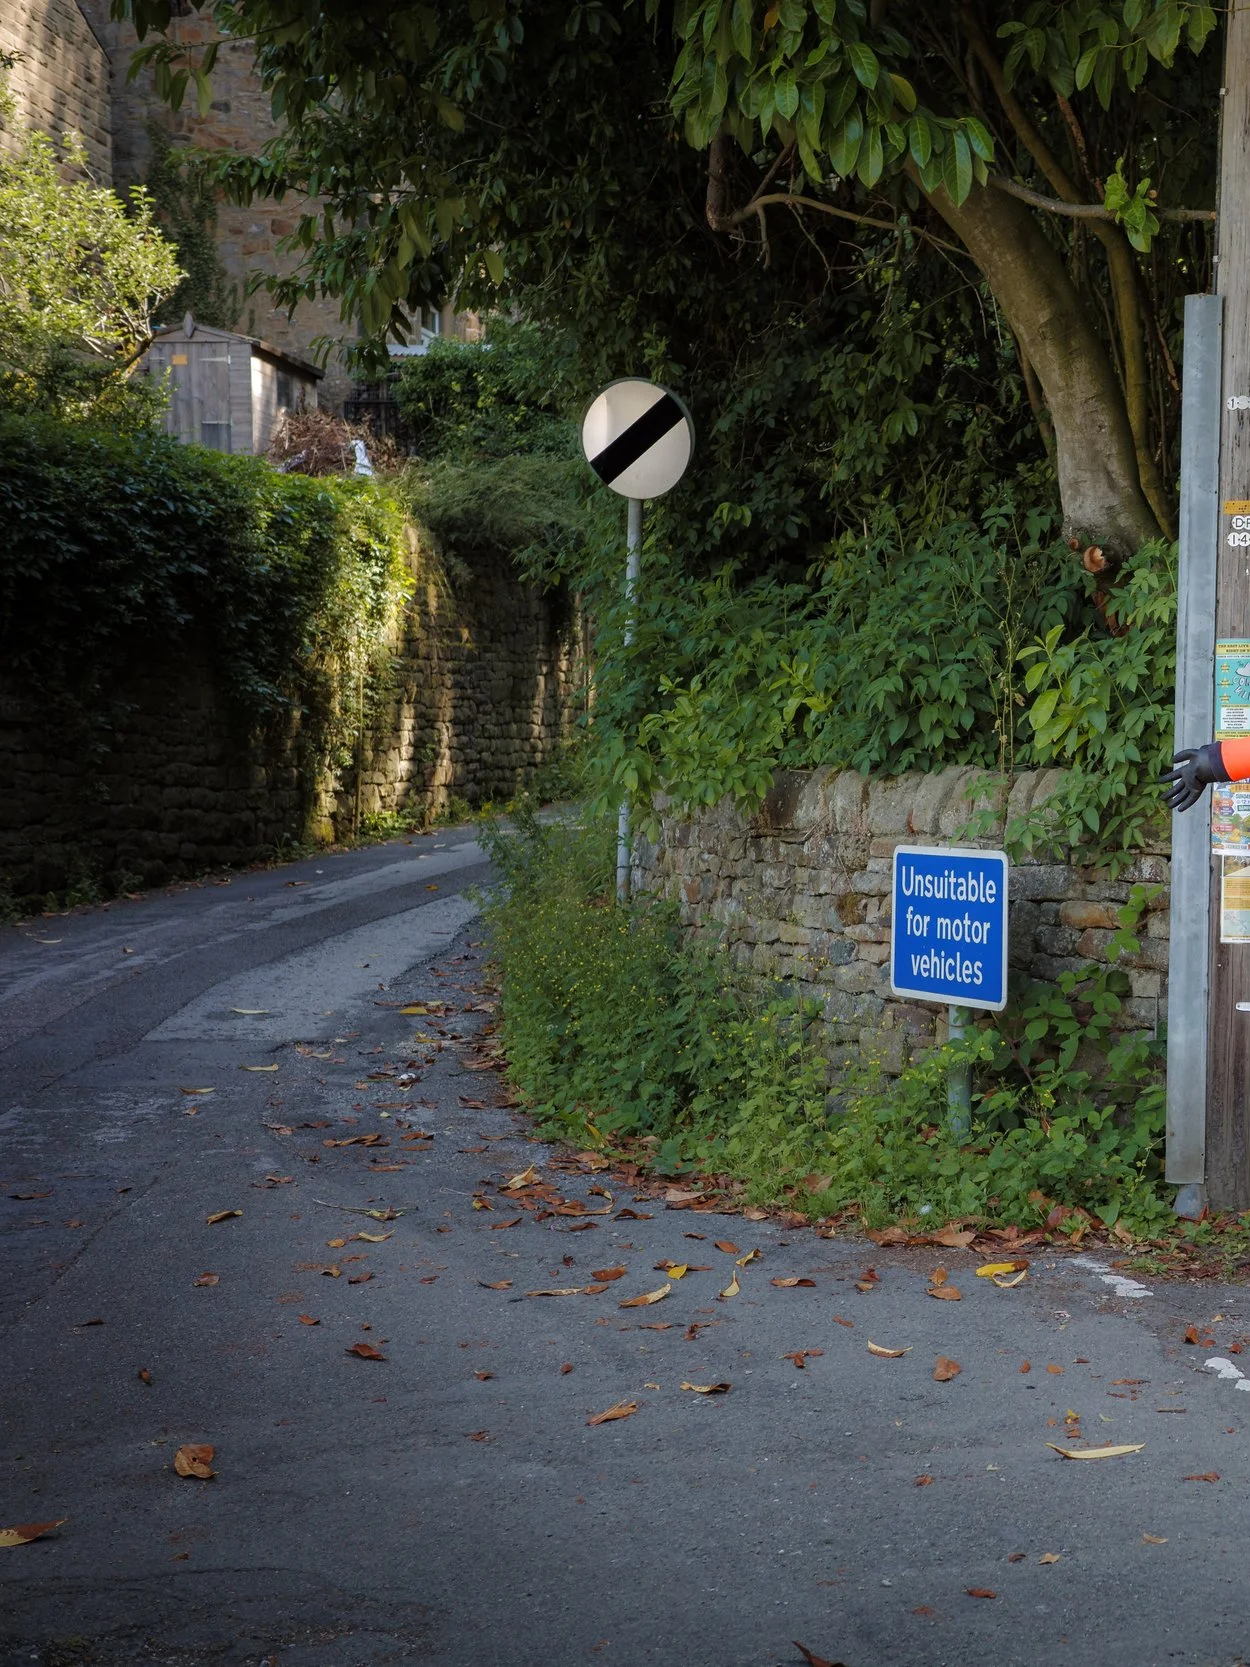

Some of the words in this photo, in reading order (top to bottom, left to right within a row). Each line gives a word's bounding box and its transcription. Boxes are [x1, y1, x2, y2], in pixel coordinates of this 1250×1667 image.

[901, 865, 997, 904] Unsuitable
[906, 905, 931, 937] for
[936, 912, 991, 945] motor
[911, 948, 984, 986] vehicles
